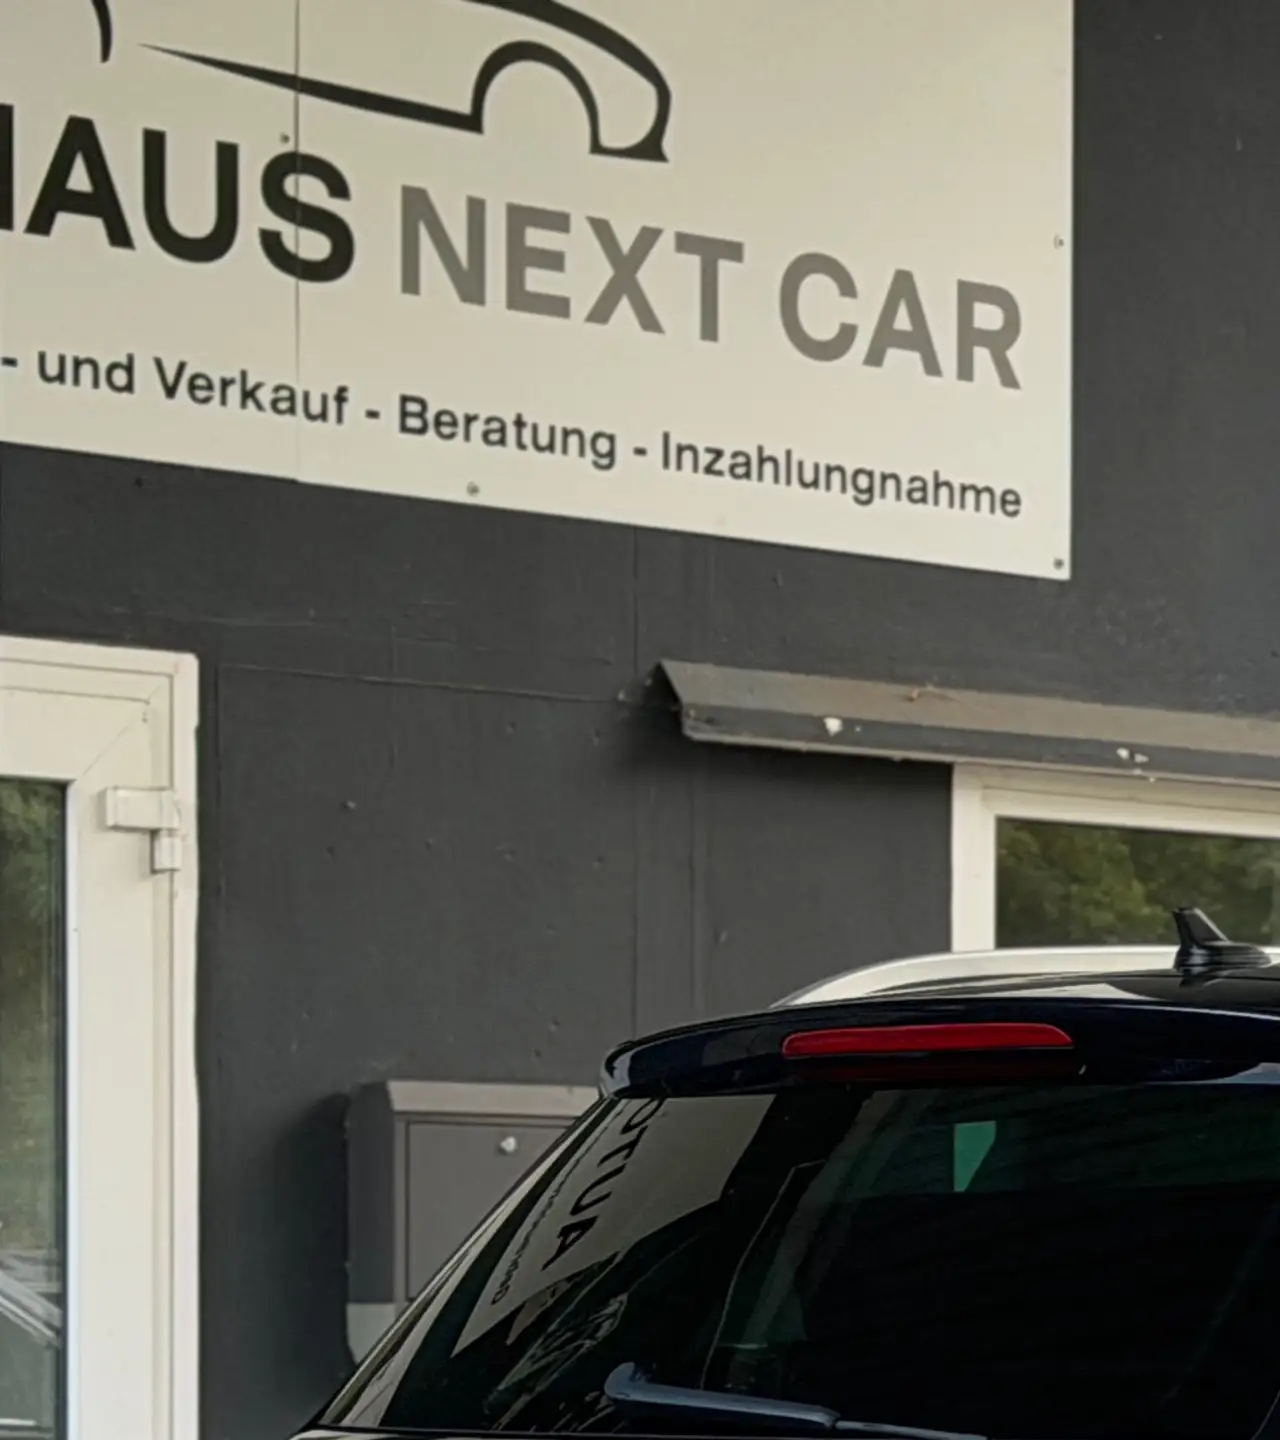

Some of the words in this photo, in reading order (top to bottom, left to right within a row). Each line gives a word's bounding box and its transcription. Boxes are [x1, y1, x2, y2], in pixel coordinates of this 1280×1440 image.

[0, 102, 356, 283] AUS
[400, 183, 744, 343] NEXT
[779, 251, 1021, 390] CAR
[37, 350, 135, 394] und
[153, 356, 349, 425] Verkauf
[399, 394, 616, 470] Beratung
[661, 431, 1022, 518] Inzahlungnahme
